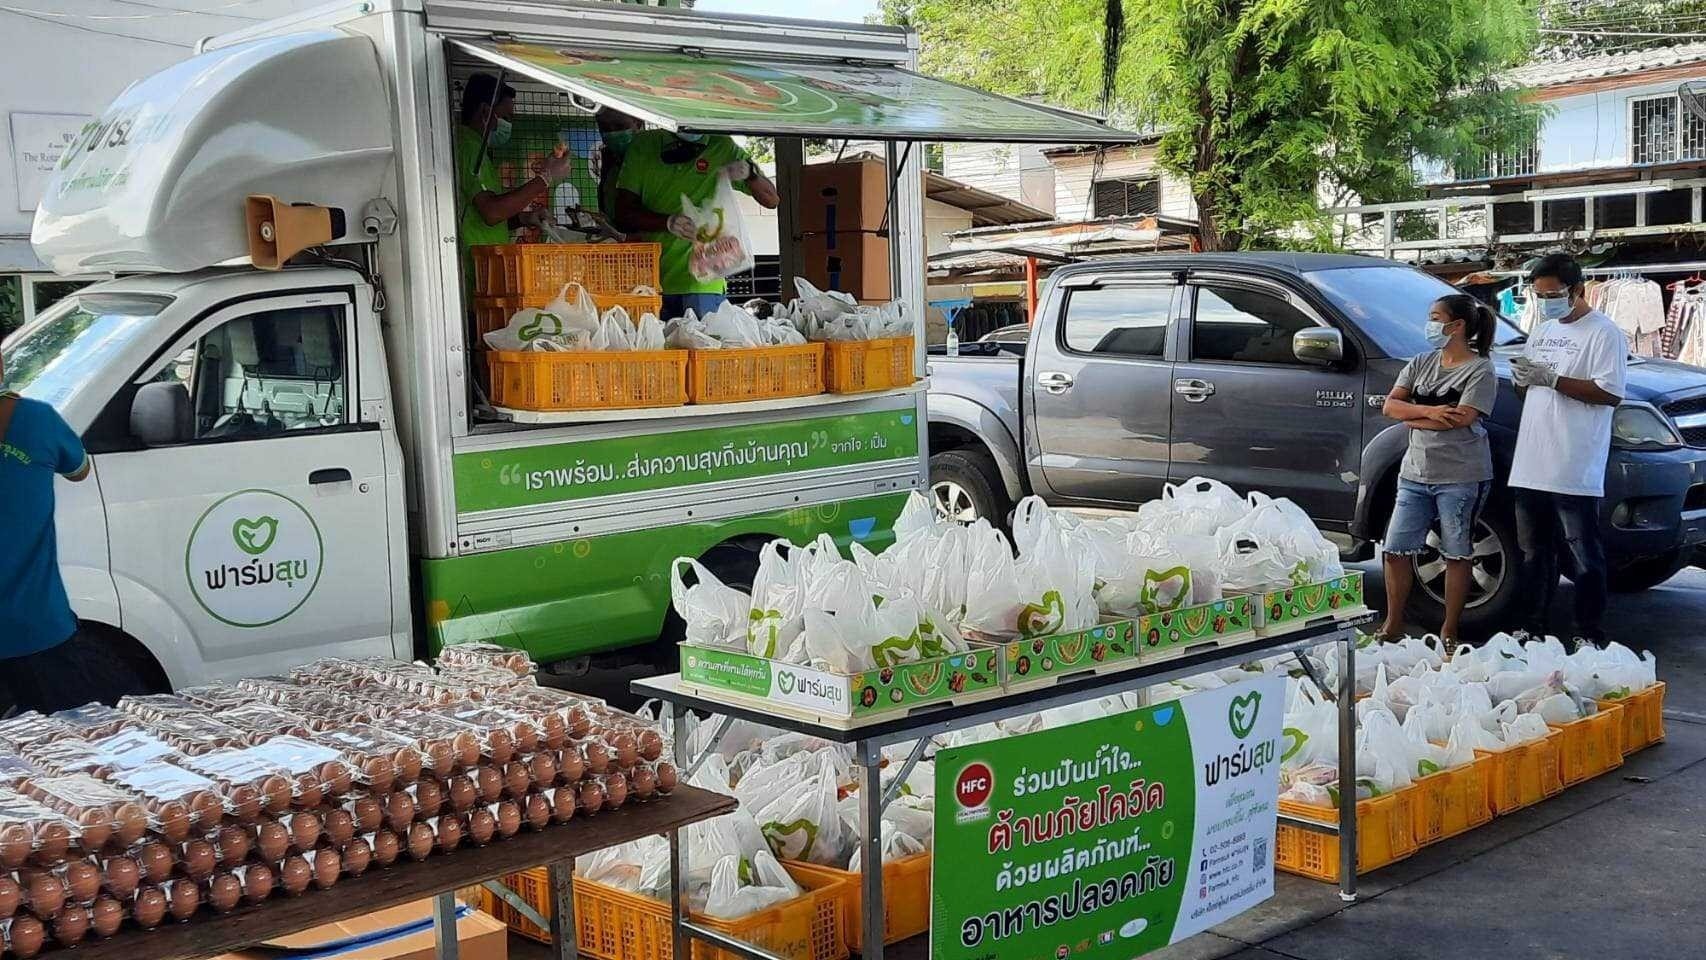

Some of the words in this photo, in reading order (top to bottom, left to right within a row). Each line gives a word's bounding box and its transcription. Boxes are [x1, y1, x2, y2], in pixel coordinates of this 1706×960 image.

[1316, 390, 1354, 400] HILUX
[205, 558, 308, 590] ฟาร์มสุข
[797, 677, 842, 706] ฟาร์มสุข
[1012, 743, 1142, 797] ร่วมปันน้ำใจ...
[1204, 738, 1275, 787] ฟาร์มสุข
[961, 777, 986, 794] HFC
[988, 778, 1165, 854] ต้านภัยโควิด
[961, 855, 1175, 948] อาหารปลอดภัย
